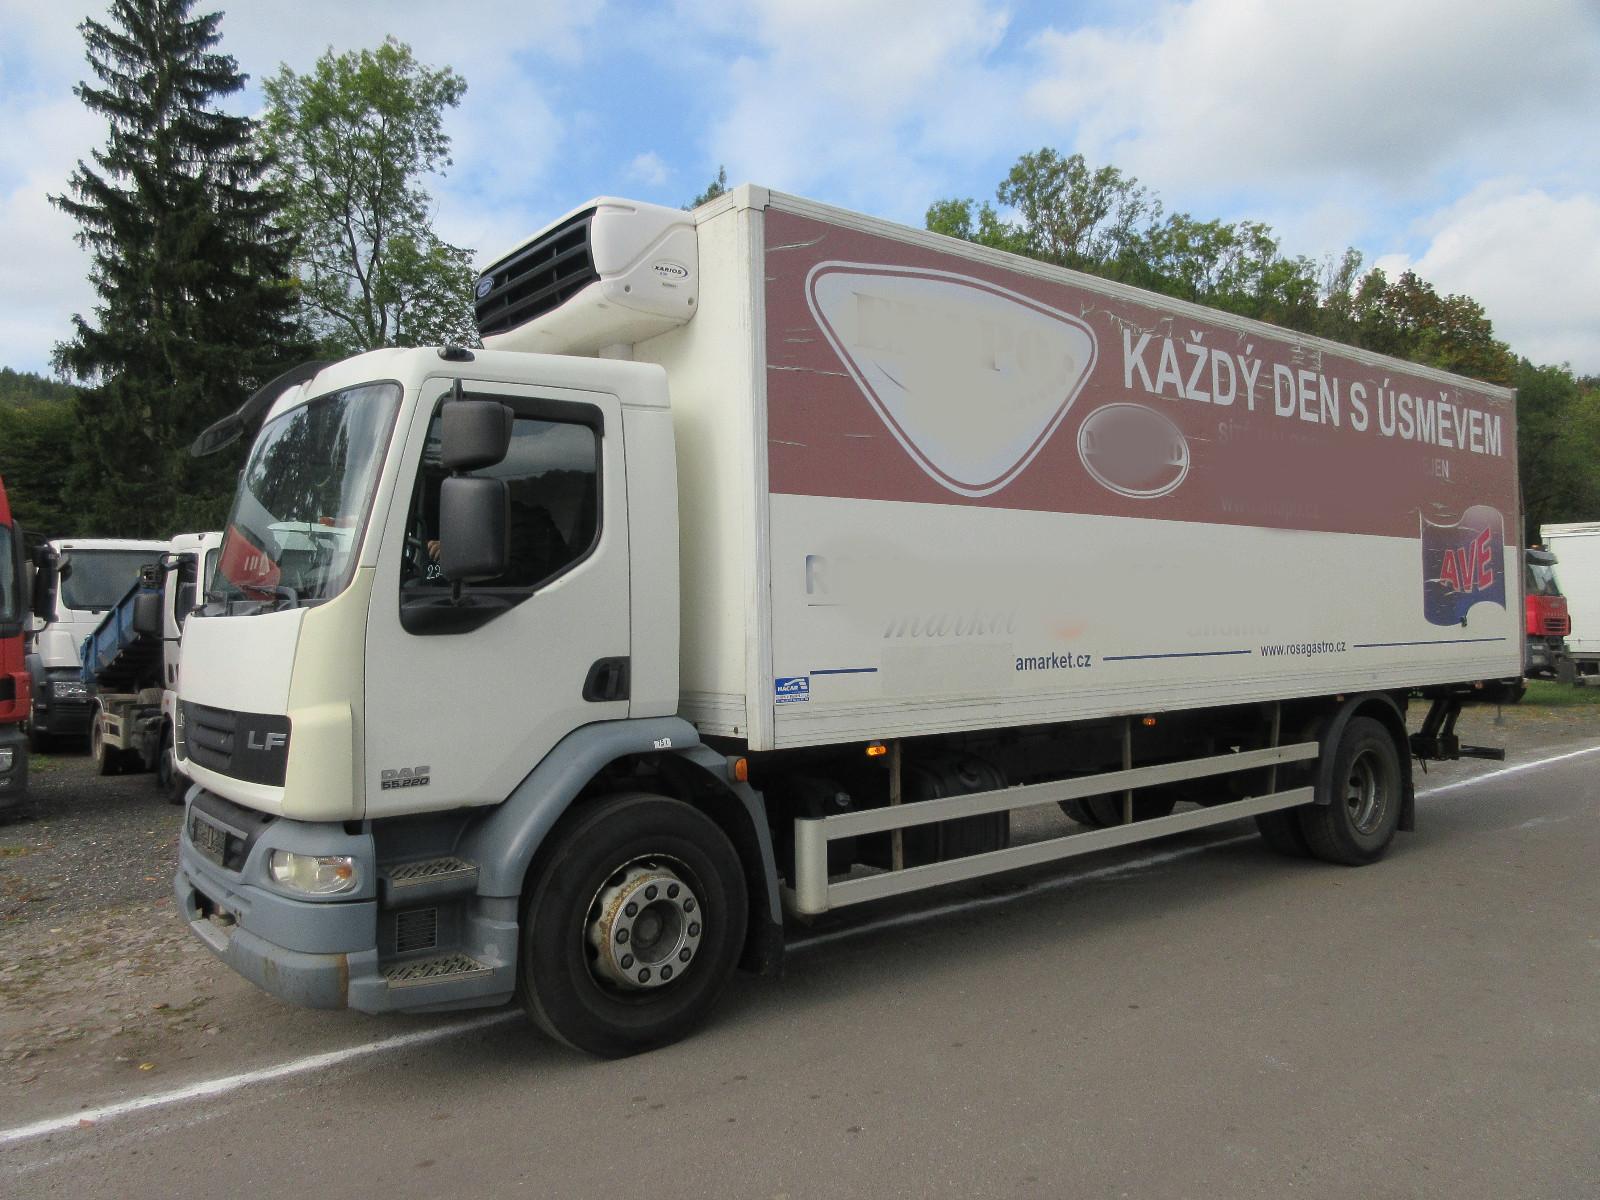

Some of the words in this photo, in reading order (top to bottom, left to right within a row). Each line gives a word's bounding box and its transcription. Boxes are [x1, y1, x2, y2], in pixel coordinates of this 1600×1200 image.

[1122, 329, 1262, 411] KAŽDÝ
[1273, 363, 1340, 426] DEN
[1350, 382, 1369, 432] S
[1377, 378, 1502, 457] ÚSMĚVEM
[1439, 527, 1494, 593] AVE
[1260, 640, 1347, 658] www.rosagastro.cz
[1015, 651, 1092, 671] amarket.cz
[247, 730, 288, 750] LF
[382, 765, 431, 780] DAF
